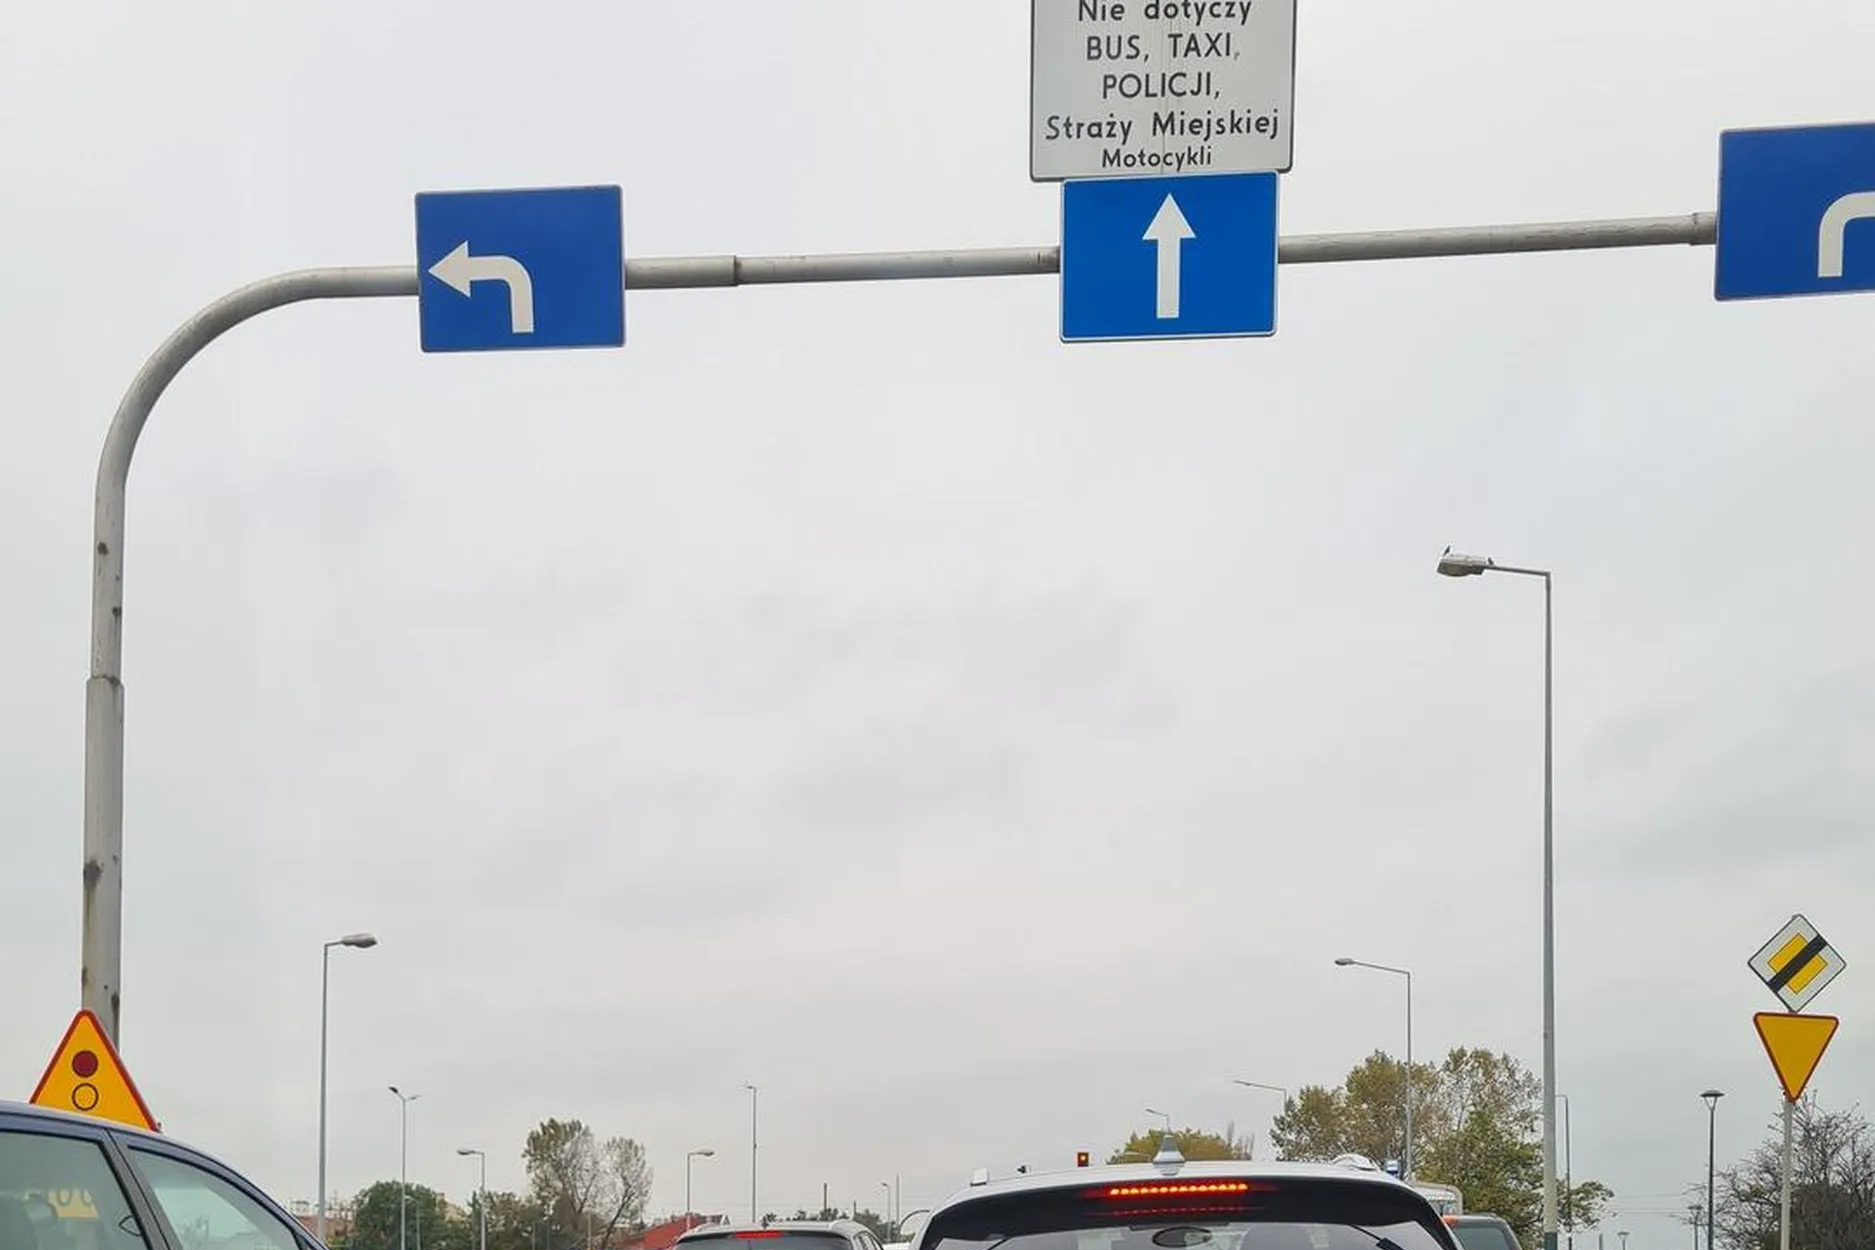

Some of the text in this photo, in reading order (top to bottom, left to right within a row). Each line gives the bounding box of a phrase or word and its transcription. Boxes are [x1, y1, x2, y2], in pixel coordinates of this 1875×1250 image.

[1079, 0, 1252, 26] Nie dotyczy
[1087, 32, 1241, 63] BUS, TAXI,
[1102, 71, 1221, 99] POLICJI,
[1045, 108, 1279, 145] Straży Miejskiej
[1102, 145, 1212, 172] Motocykli
